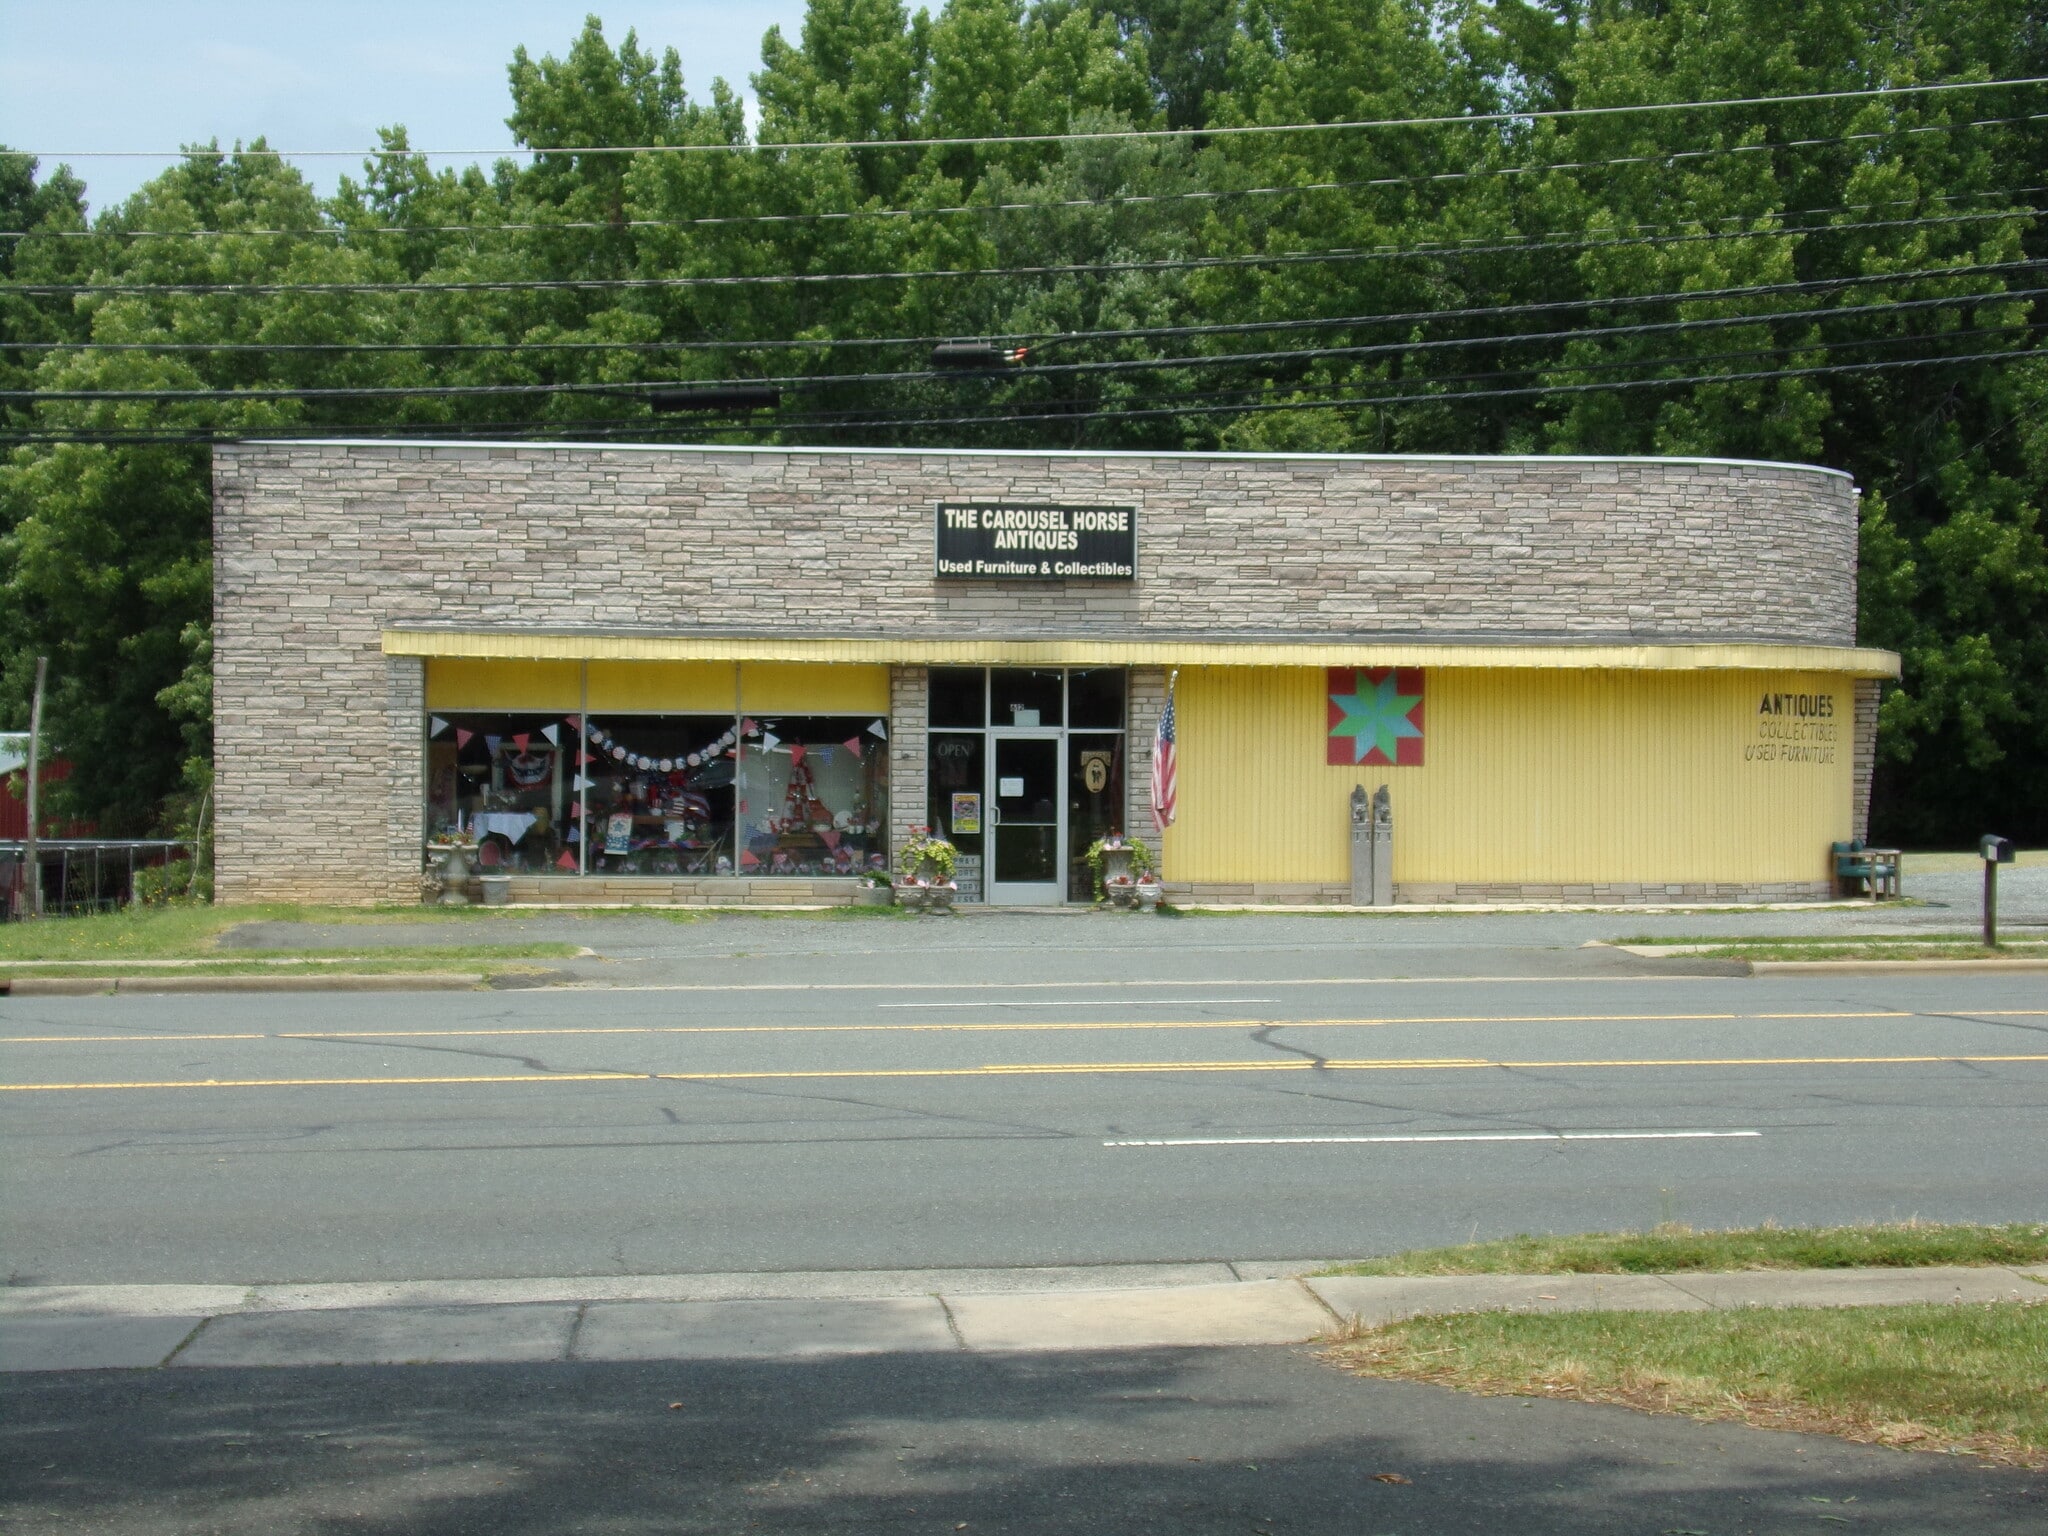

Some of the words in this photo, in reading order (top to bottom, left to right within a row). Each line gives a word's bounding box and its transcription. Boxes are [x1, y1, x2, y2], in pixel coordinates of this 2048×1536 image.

[944, 508, 978, 528] THE
[982, 509, 1069, 530] CAROUSEL
[1073, 511, 1129, 531] HORSE
[994, 530, 1078, 550] ANTIQUES
[939, 559, 972, 573] Used
[976, 560, 1037, 574] Furniture
[1040, 561, 1051, 574] &
[1054, 561, 1132, 575] Collectibles
[1759, 693, 1834, 720] ANTIQUES
[938, 743, 969, 757] OPEN
[1744, 743, 1777, 762] USED
